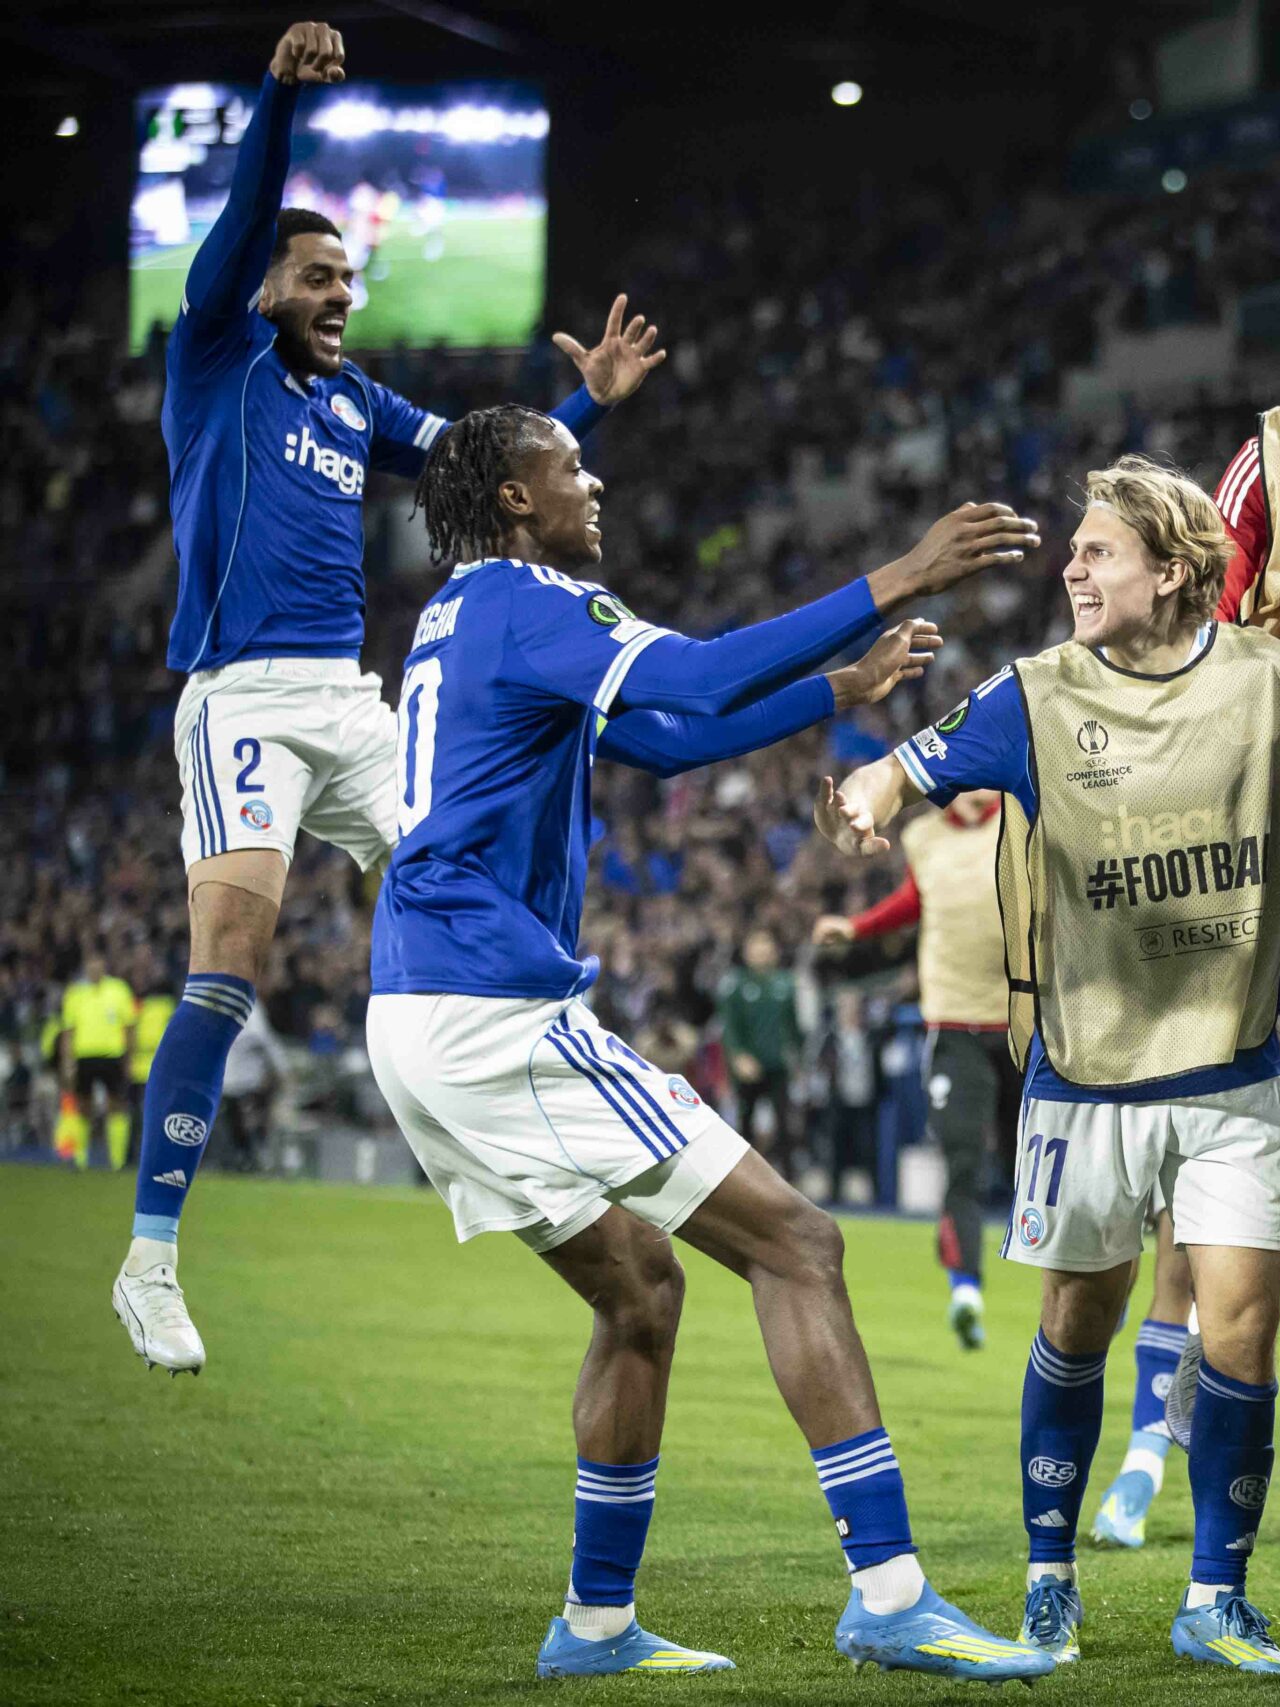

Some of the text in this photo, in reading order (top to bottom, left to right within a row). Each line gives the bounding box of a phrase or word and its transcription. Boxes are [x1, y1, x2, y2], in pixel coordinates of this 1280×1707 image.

[234, 737, 265, 793] 2
[1066, 765, 1133, 782] CONFERENCE
[1082, 777, 1120, 789] LEAGUE
[1027, 1133, 1069, 1207] 11
